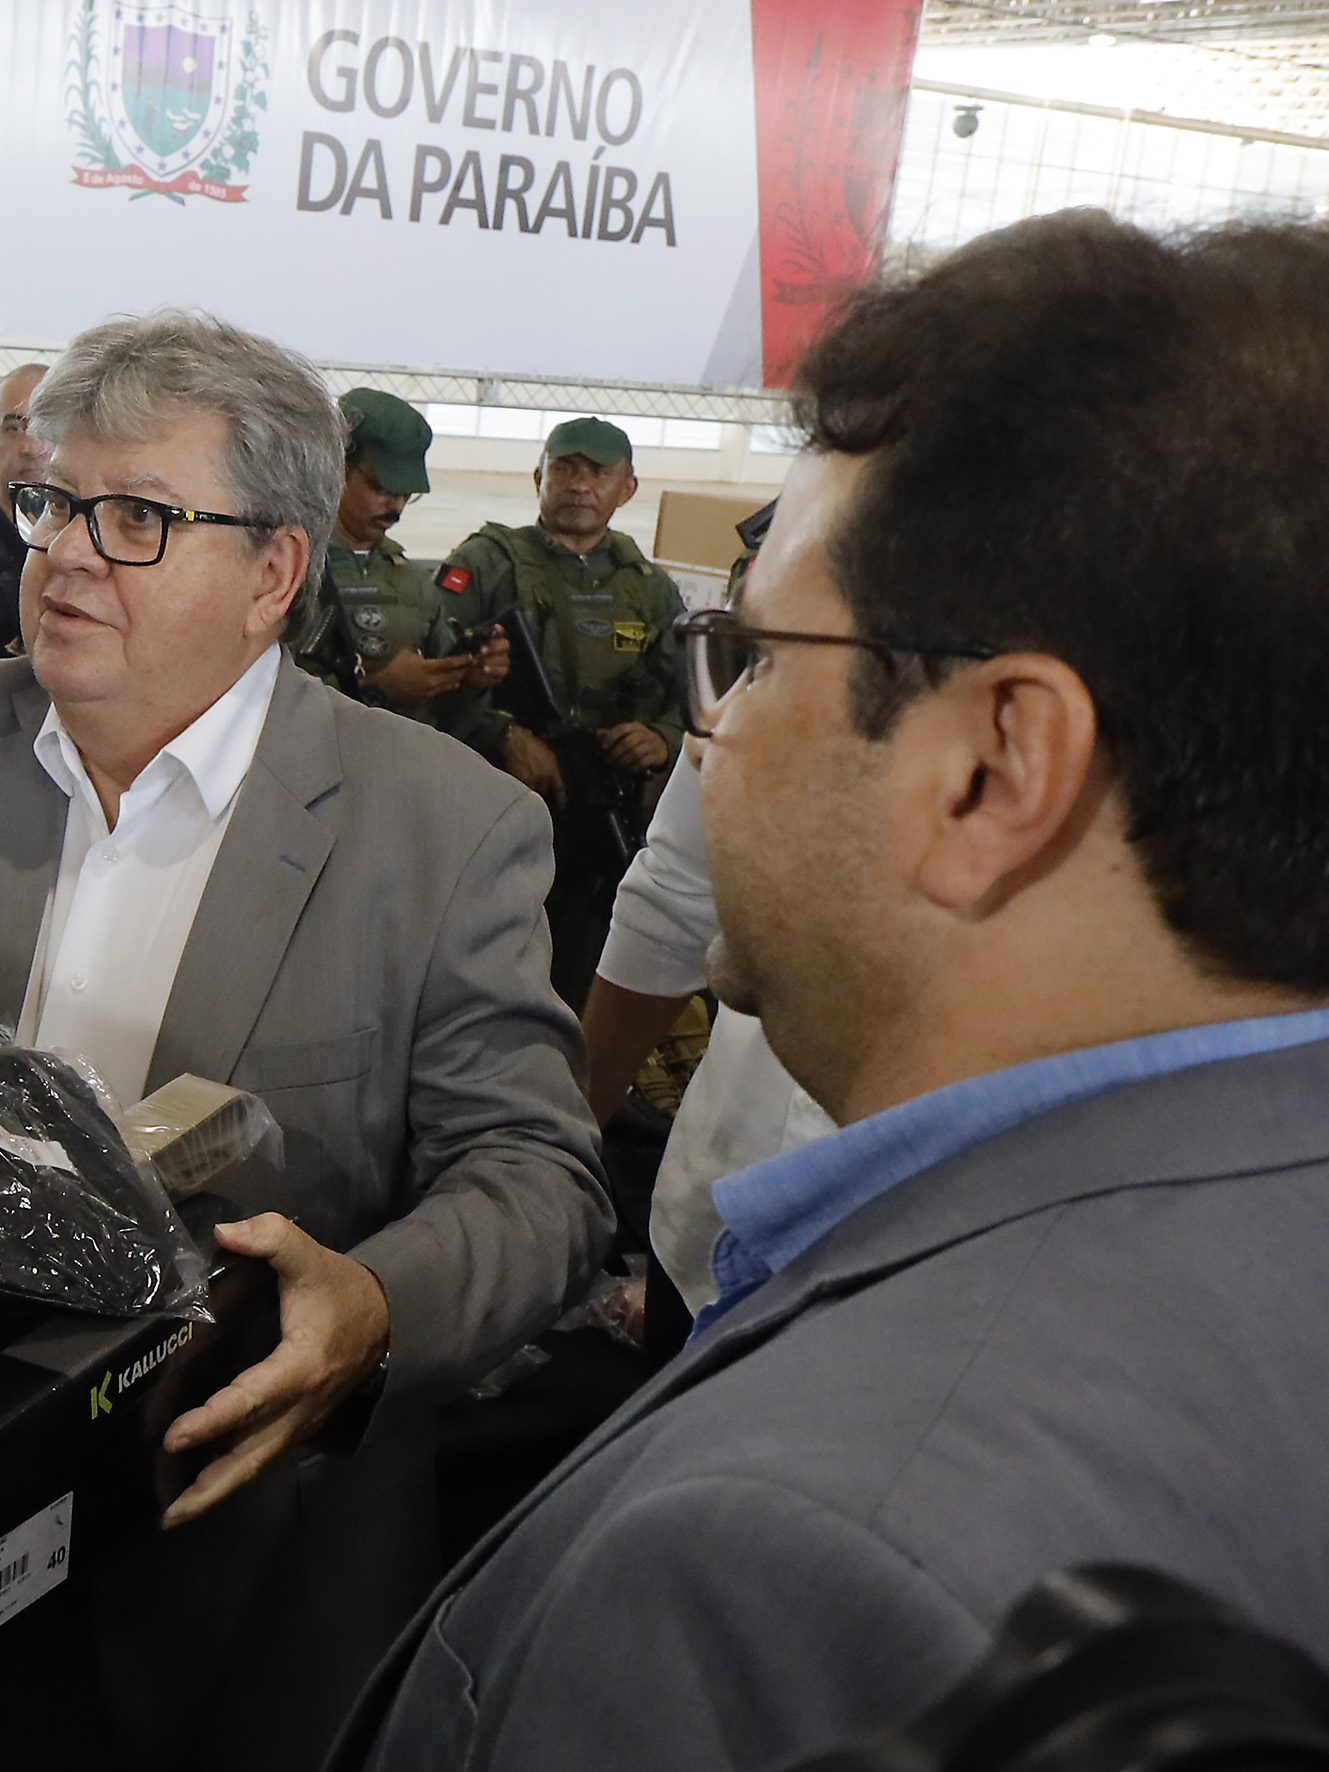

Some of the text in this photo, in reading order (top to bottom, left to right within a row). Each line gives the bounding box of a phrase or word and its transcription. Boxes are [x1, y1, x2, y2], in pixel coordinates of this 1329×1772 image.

[307, 28, 643, 147] GOVERNO
[92, 173, 104, 183] de
[106, 172, 144, 185] Agosto
[188, 181, 202, 192] de
[296, 130, 677, 248] DA PARAÍBA
[118, 1321, 193, 1394] KALLUCCI
[47, 1545, 66, 1570] 40
